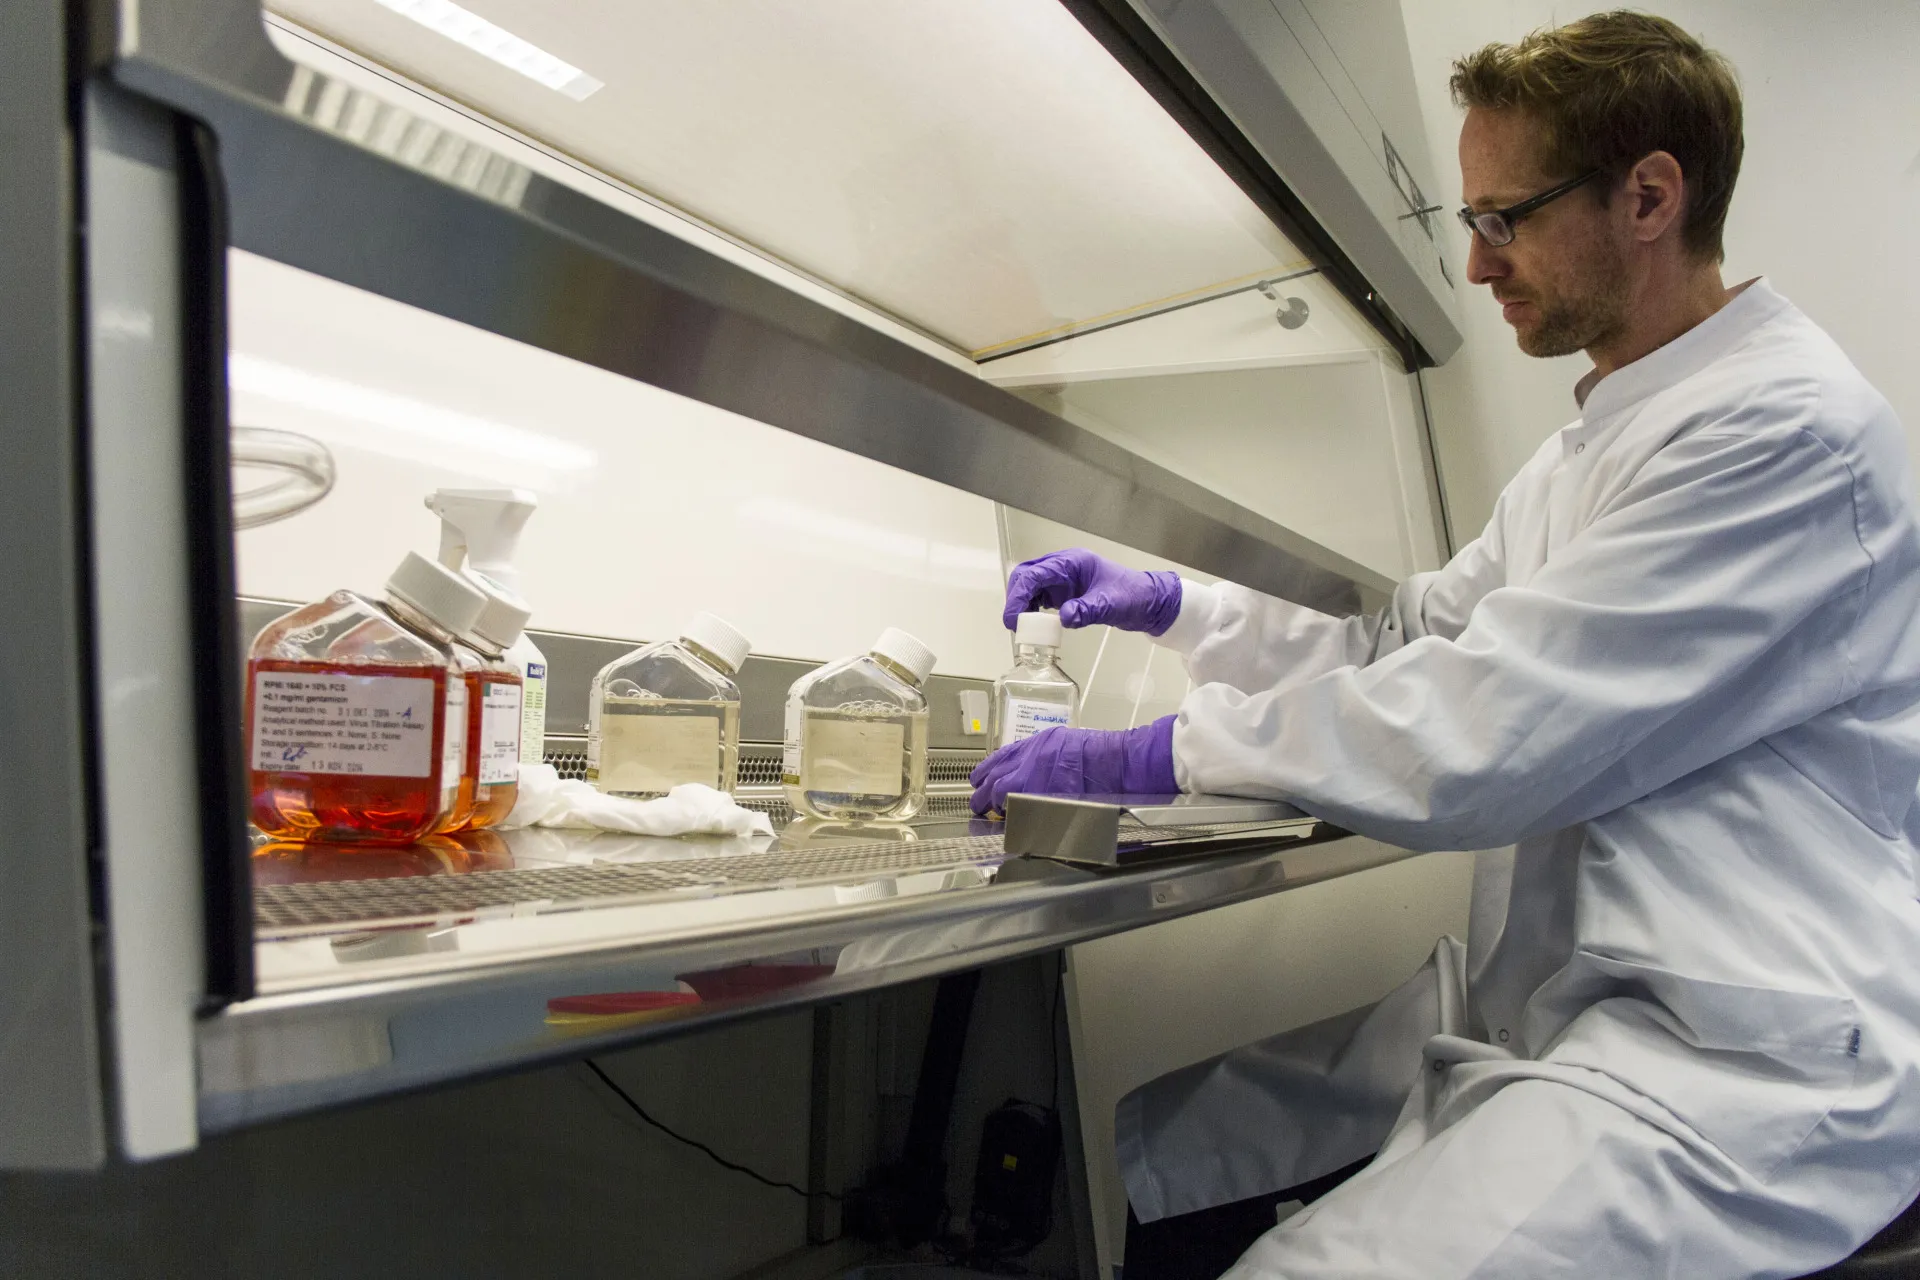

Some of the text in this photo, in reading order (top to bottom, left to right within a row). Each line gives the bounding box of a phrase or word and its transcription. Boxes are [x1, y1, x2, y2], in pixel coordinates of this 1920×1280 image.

[306, 695, 348, 703] gentamicin
[263, 704, 293, 714] Reagent
[295, 705, 315, 713] batch
[263, 717, 296, 726] Analytical
[299, 718, 325, 726] method
[349, 719, 368, 728] Virus
[261, 739, 289, 749] Storage
